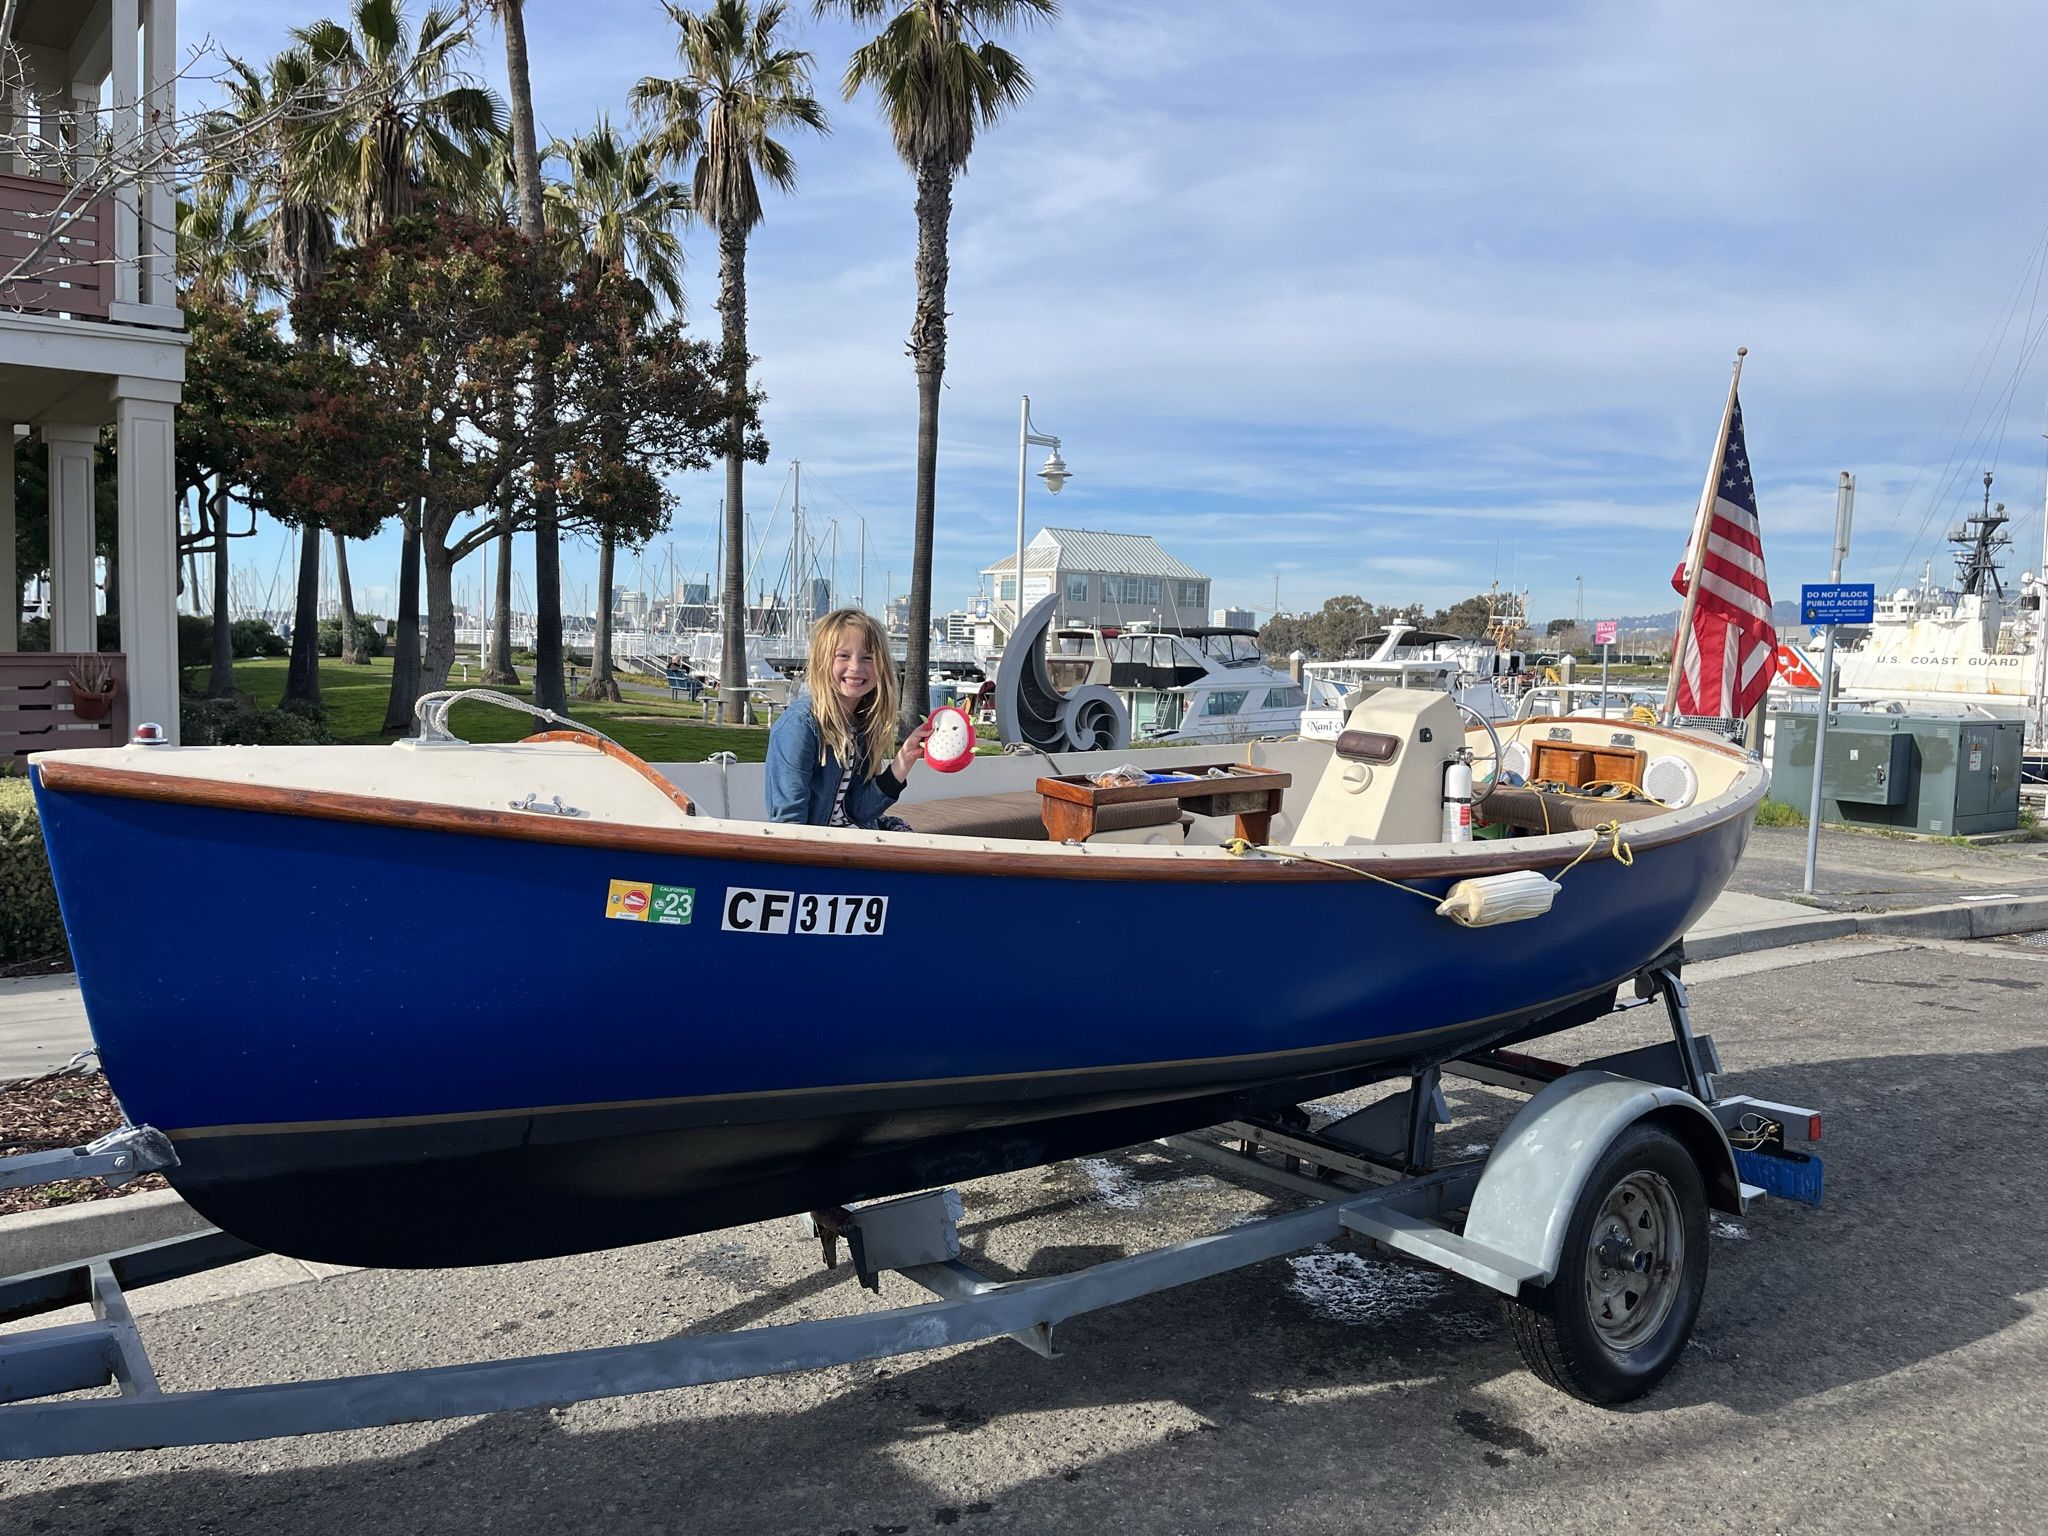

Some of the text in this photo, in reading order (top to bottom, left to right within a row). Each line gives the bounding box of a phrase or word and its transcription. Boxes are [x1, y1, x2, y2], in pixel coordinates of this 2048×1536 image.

[1876, 655, 2019, 667] U.S. COAST GUARD
[1307, 721, 1333, 732] Nani
[659, 886, 689, 894] CALIFORNIA
[663, 893, 693, 917] 23
[727, 891, 884, 934] CF 3179
